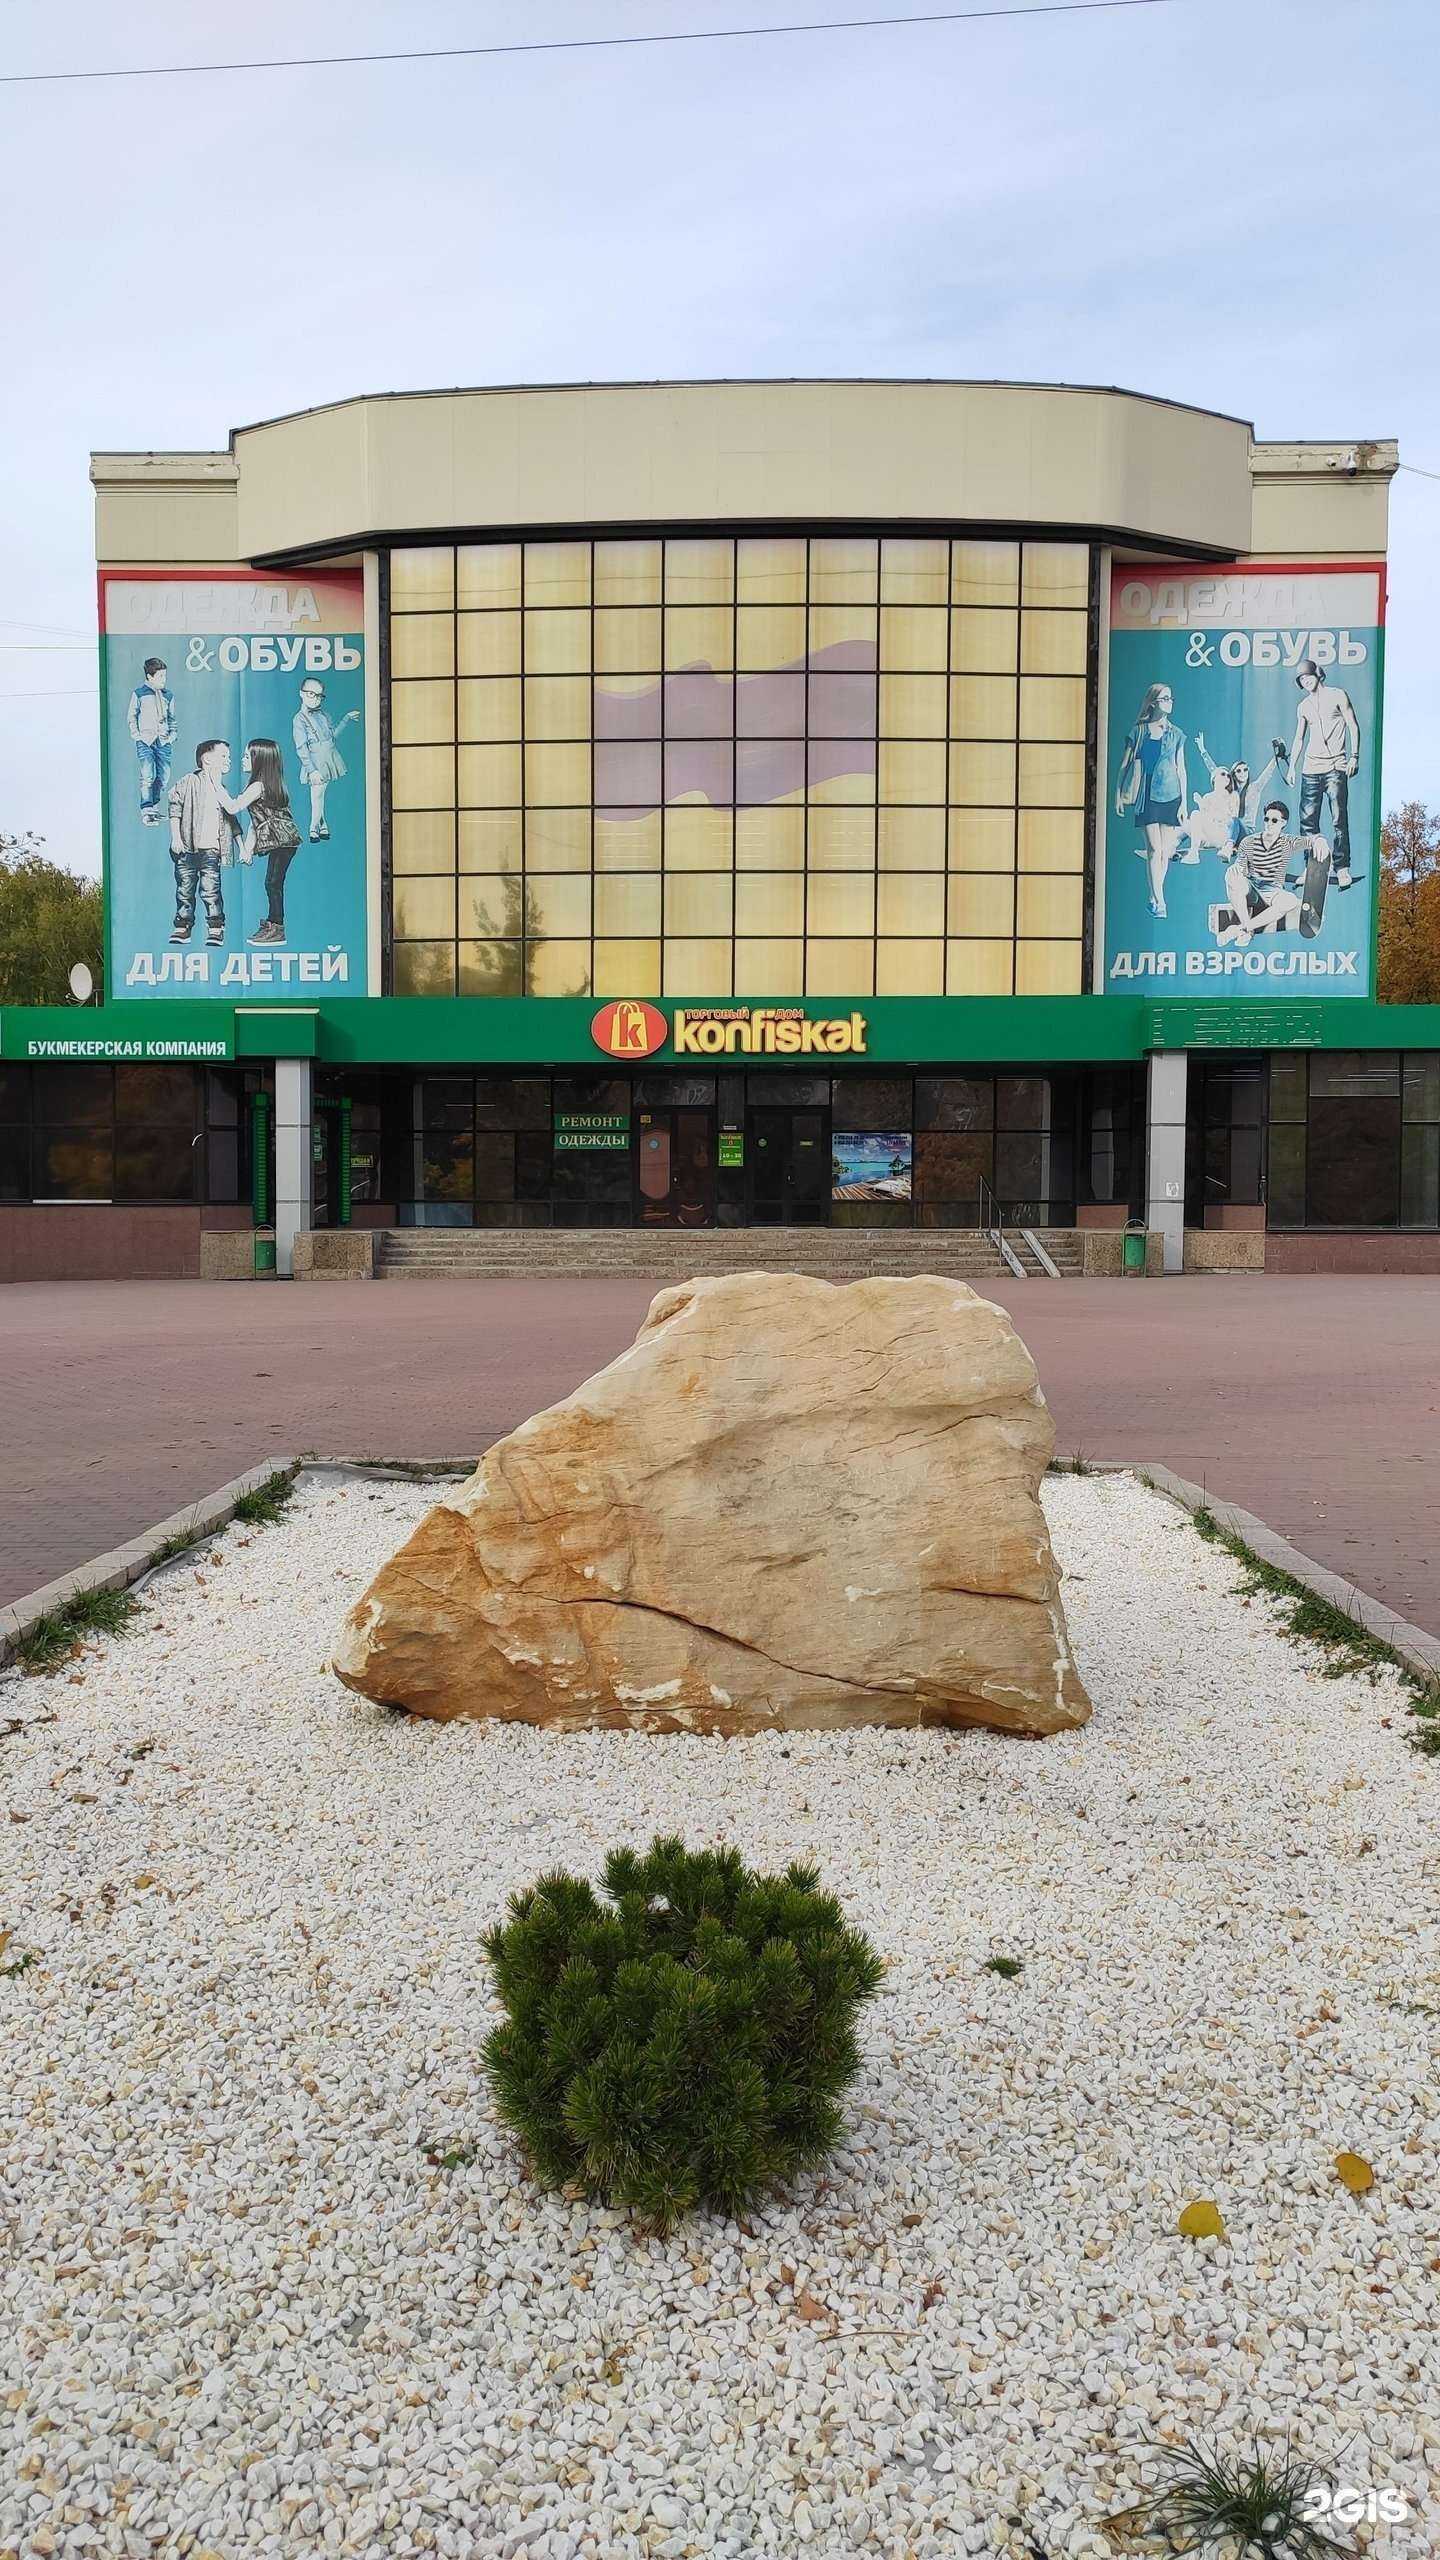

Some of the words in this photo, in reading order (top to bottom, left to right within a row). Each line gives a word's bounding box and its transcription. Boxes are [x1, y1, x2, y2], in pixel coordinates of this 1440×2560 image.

[129, 587, 321, 631] ОДЕЖДА
[1119, 581, 1328, 626] ОДЕЖДА
[126, 953, 208, 986] ДЛЯ
[219, 945, 349, 986] ДЕТЕЙ
[1110, 952, 1176, 979] ДЛЯ
[1185, 951, 1359, 977] ВЗРОСЛЫХ
[685, 1006, 750, 1020] ТОРГОВЫЙ
[774, 1008, 804, 1020] ДОМ
[674, 1009, 867, 1053] konfiskat
[28, 1041, 142, 1055] БУКМЕКЕРСКАЯ
[146, 1041, 226, 1055] КОМПАНИЯ
[561, 1116, 622, 1127] РЕМОНТ
[559, 1134, 625, 1147] ОДЕЖДЫ
